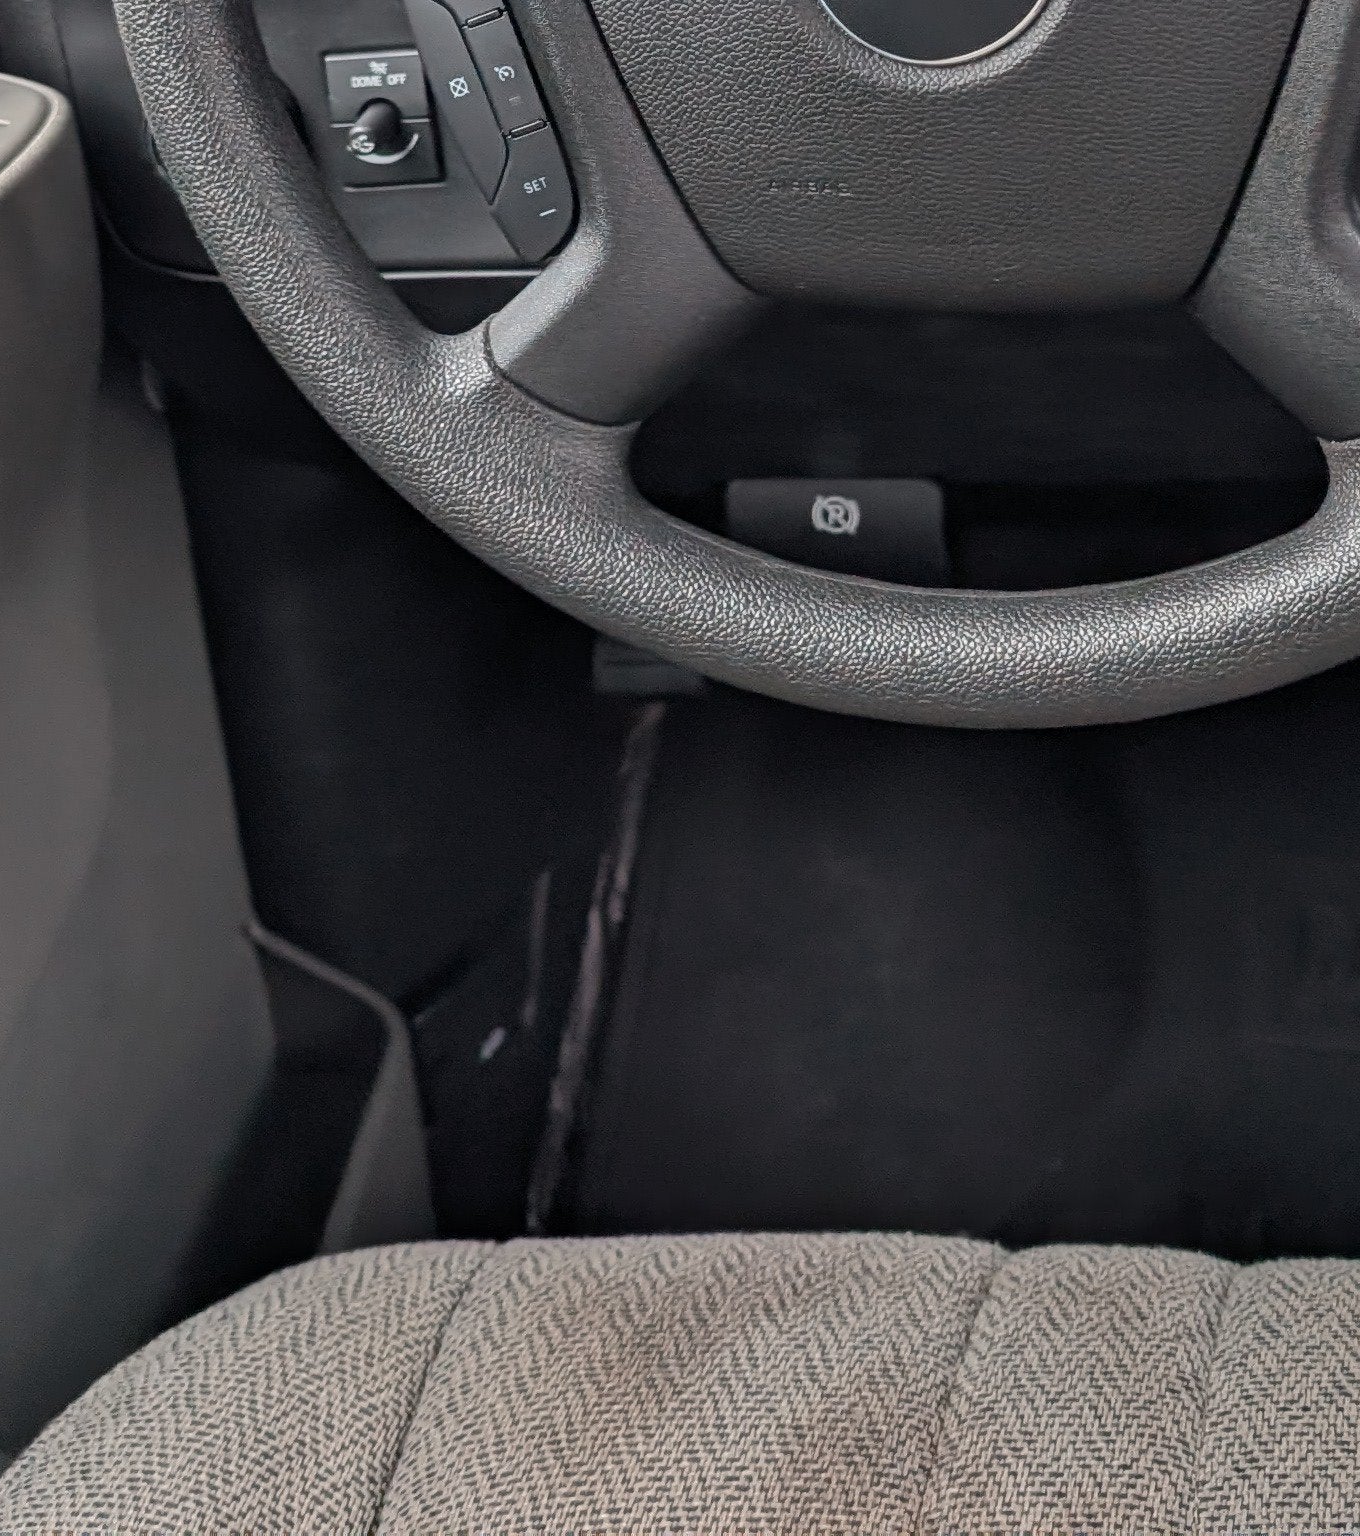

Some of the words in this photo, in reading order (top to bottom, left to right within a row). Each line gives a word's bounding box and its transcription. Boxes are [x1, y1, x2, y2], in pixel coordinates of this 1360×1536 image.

[351, 75, 383, 89] DOME
[386, 73, 407, 87] OFF
[523, 176, 548, 195] SET
